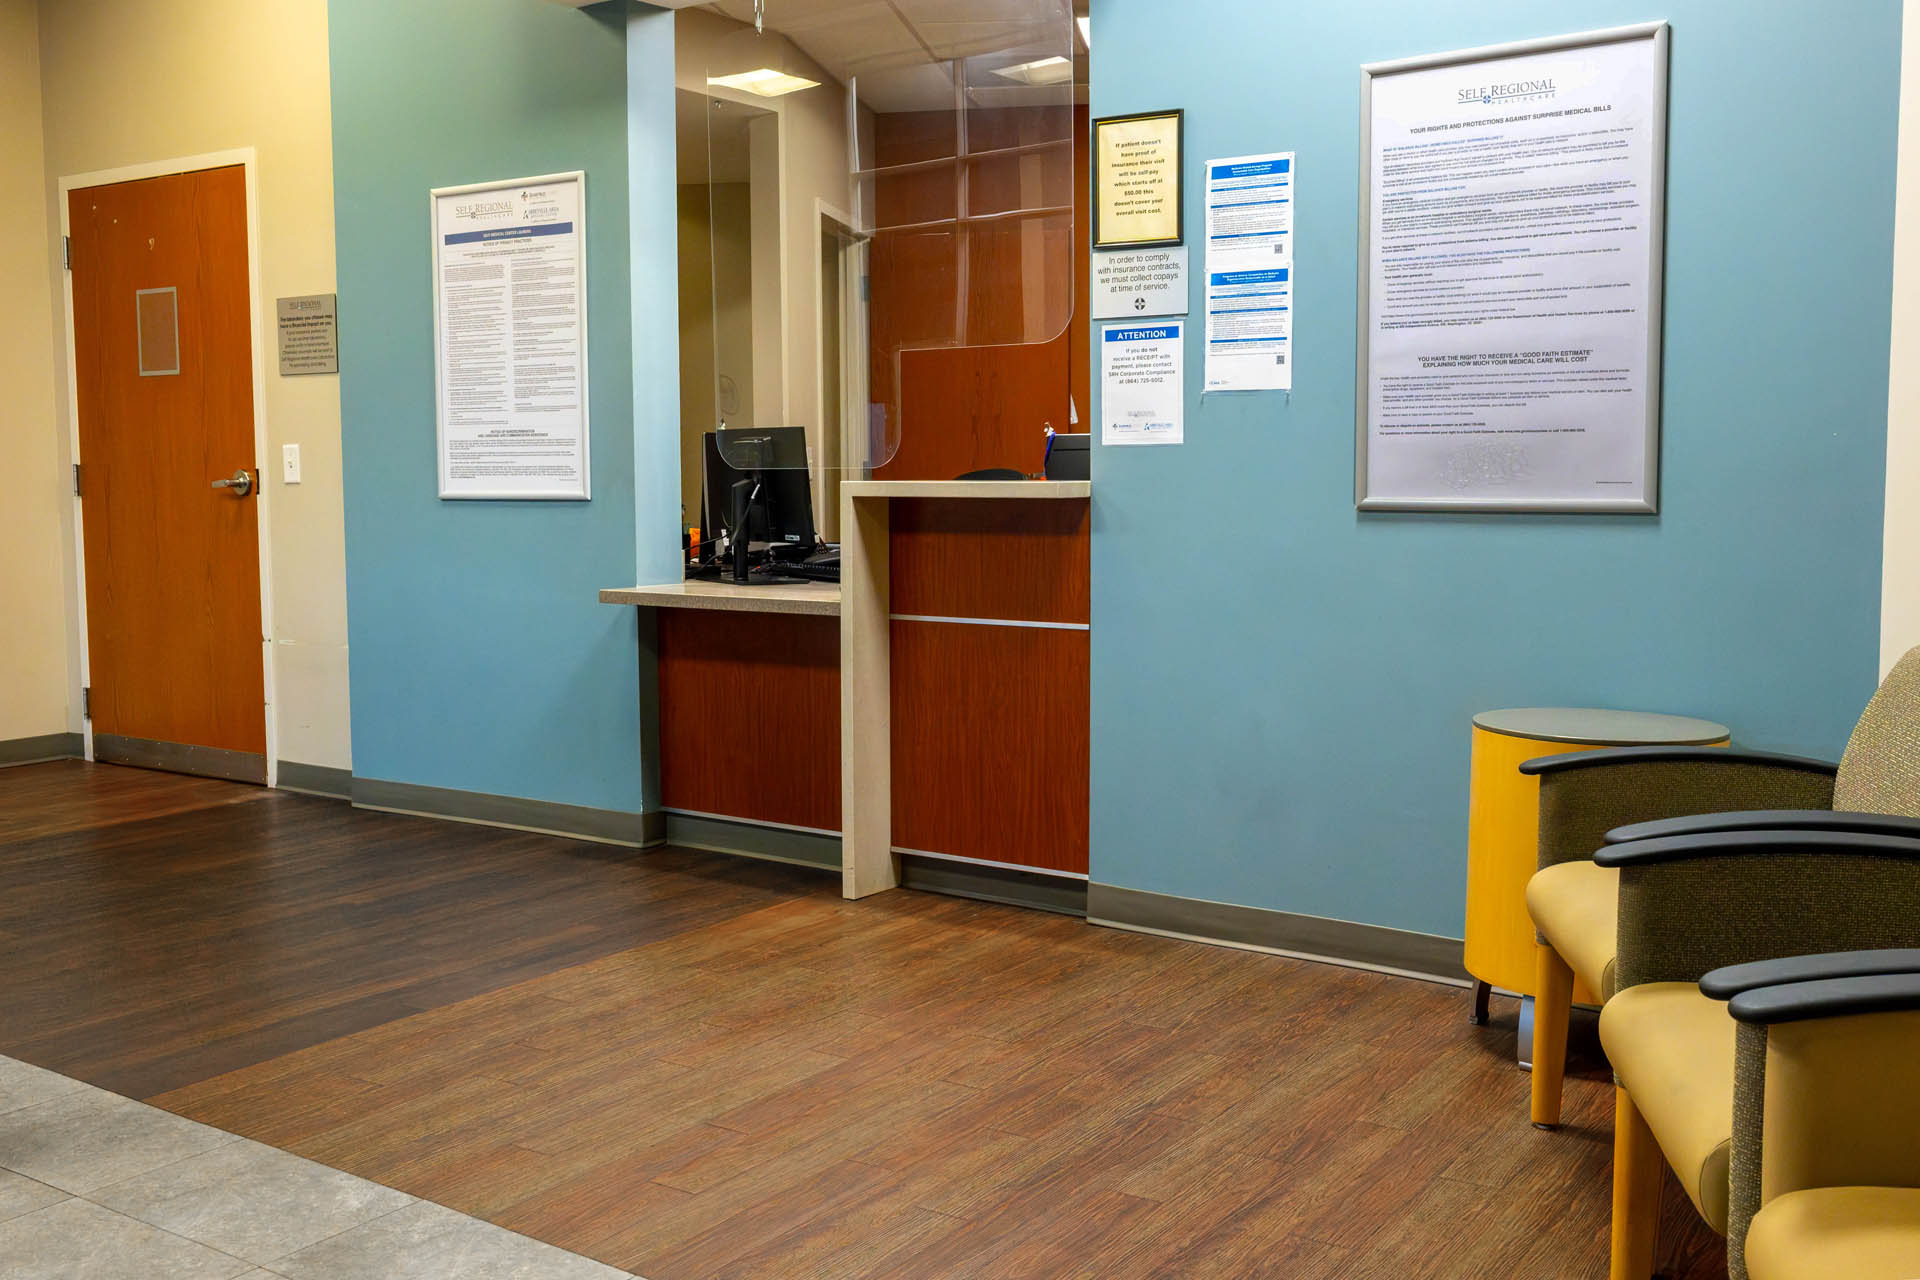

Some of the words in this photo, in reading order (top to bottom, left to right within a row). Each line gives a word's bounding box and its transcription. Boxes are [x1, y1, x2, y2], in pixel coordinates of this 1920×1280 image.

[1458, 87, 1487, 101] SELF
[1491, 78, 1556, 96] REGIONAL
[1491, 92, 1556, 104] HEALTHCARE
[1410, 127, 1426, 135] YOUR
[1449, 122, 1461, 130] AND
[1462, 118, 1504, 128] PROTECTIONS
[1505, 114, 1531, 123] AGAINST
[1532, 110, 1564, 120] SURPRISE
[1564, 107, 1592, 116] MEDICAL
[1593, 104, 1612, 112] BILLS
[475, 200, 512, 212] REGIONAL
[1117, 256, 1135, 264] order
[1145, 253, 1170, 262] comply
[1098, 266, 1111, 275] with
[1113, 265, 1145, 274] insurance
[1148, 262, 1181, 271] contracts,
[1130, 274, 1152, 282] collect
[1154, 273, 1178, 281] copays
[1110, 285, 1116, 293] at
[1143, 282, 1170, 290] service.
[1117, 330, 1167, 340] ATTENTION
